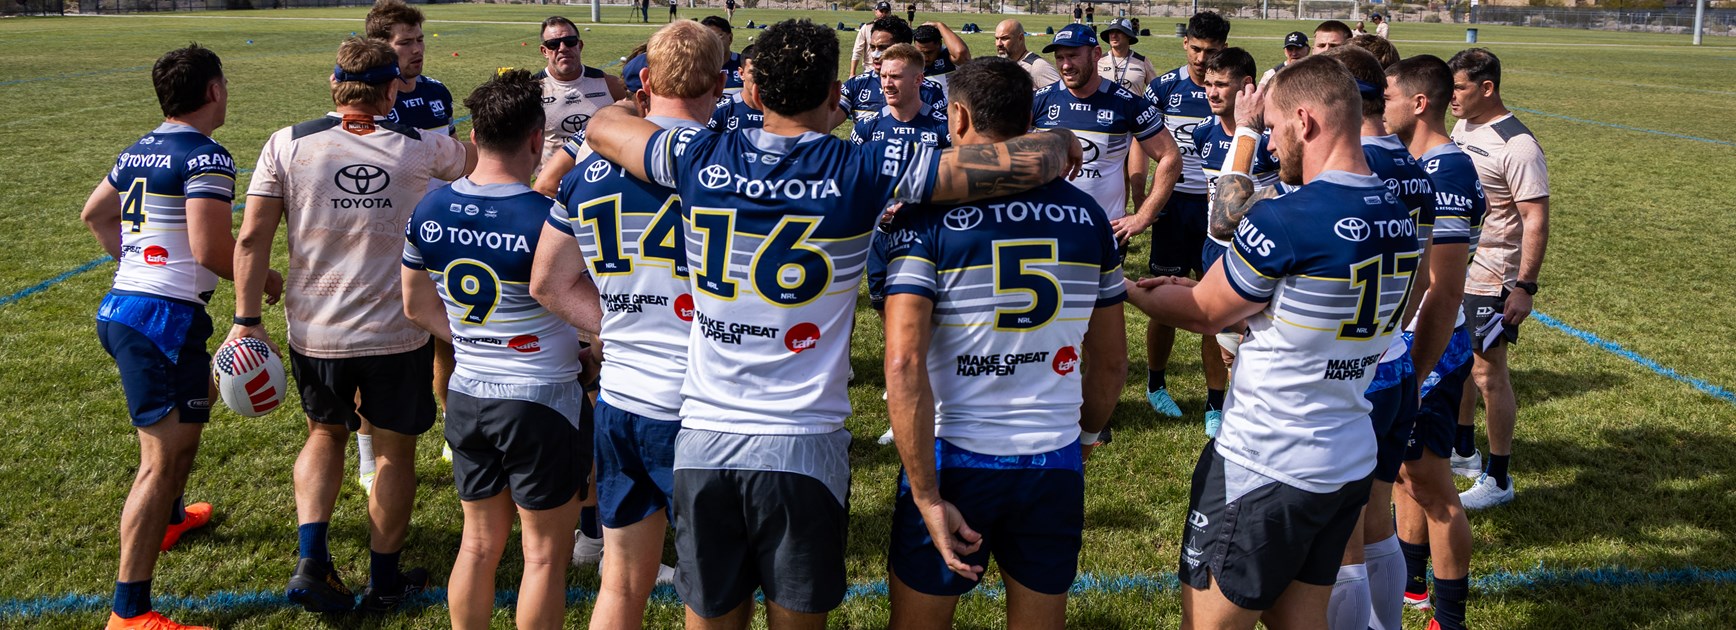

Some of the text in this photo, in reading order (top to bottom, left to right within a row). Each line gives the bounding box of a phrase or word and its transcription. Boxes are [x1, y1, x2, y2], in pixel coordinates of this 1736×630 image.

[402, 97, 424, 108] YETI
[1191, 91, 1208, 99] YET
[429, 100, 445, 112] 30
[1069, 102, 1091, 111] YETI
[1097, 109, 1114, 120] 30
[1136, 104, 1157, 125] BRA
[921, 131, 938, 141] 30
[1218, 140, 1233, 149] YET
[127, 153, 172, 169] TOYOTA
[187, 153, 236, 171] BRAV
[734, 173, 842, 200] TOYOTA
[121, 177, 150, 234] 4
[332, 198, 392, 209] TOYOTA
[1435, 192, 1472, 209] AVUS
[988, 201, 1095, 226] TOYOTA
[447, 226, 530, 253] TOYOTA
[578, 193, 690, 281] 14
[690, 206, 833, 308] 16
[443, 258, 503, 327] 9
[706, 280, 719, 290] NRL
[992, 238, 1064, 332] 5
[600, 293, 669, 306] MAKE GREAT
[780, 292, 797, 300] NRL
[1336, 250, 1419, 340] 17
[680, 308, 696, 317] ta
[697, 310, 779, 339] MAKE GREAT
[957, 351, 1049, 366] MAKE GREAT
[1326, 359, 1360, 370] MAKE
[956, 365, 1016, 377] HAPPEN
